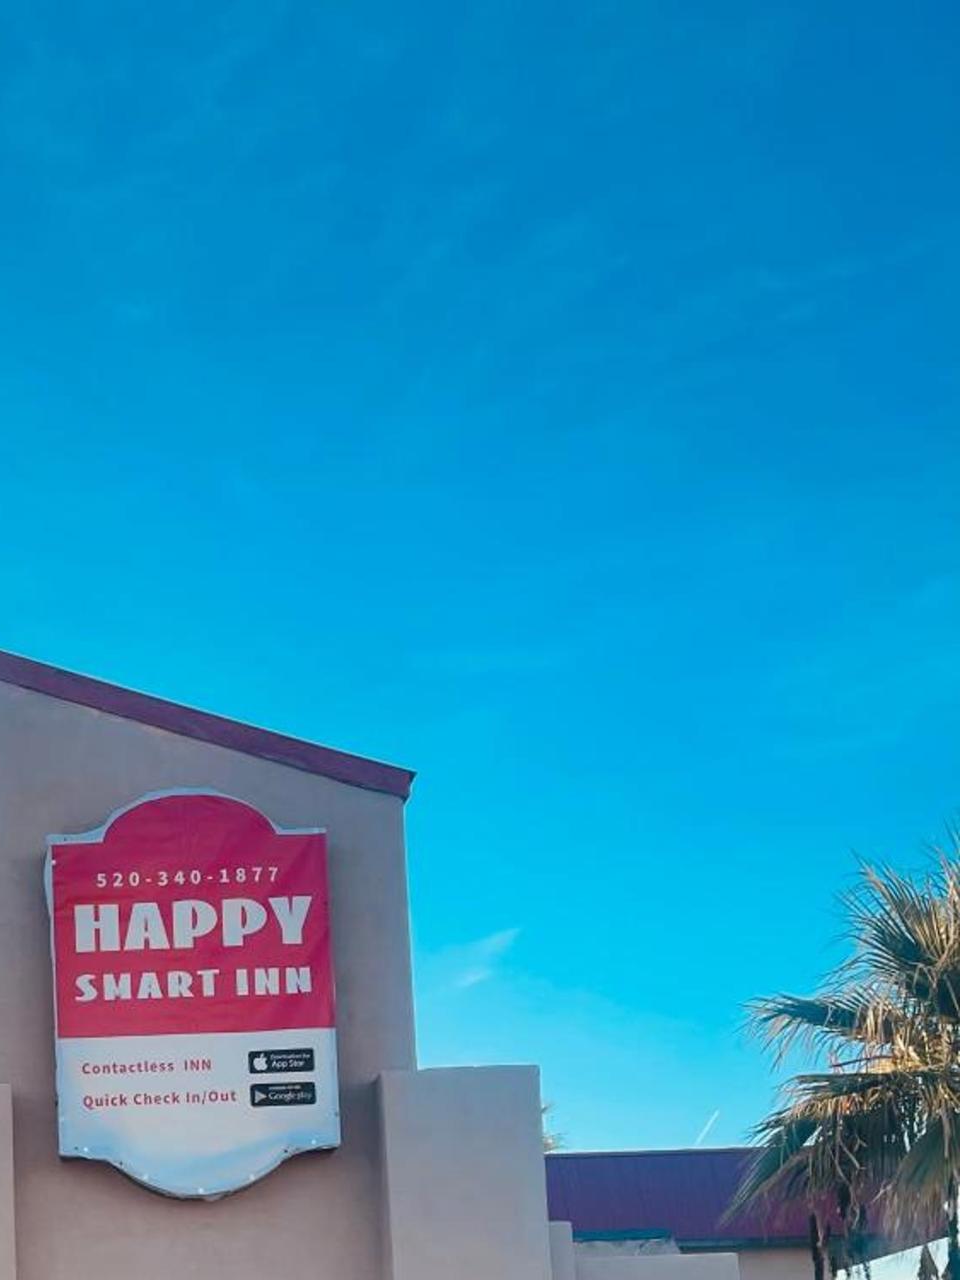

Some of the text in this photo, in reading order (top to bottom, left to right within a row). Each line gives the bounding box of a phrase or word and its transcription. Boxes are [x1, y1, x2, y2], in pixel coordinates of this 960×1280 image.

[96, 867, 279, 887] 520-340-1877
[74, 896, 313, 952] HAPPY
[75, 967, 312, 1001] SMART INN
[82, 1059, 212, 1074] Contactless INN
[83, 1090, 237, 1109] Quick Check In/Out
